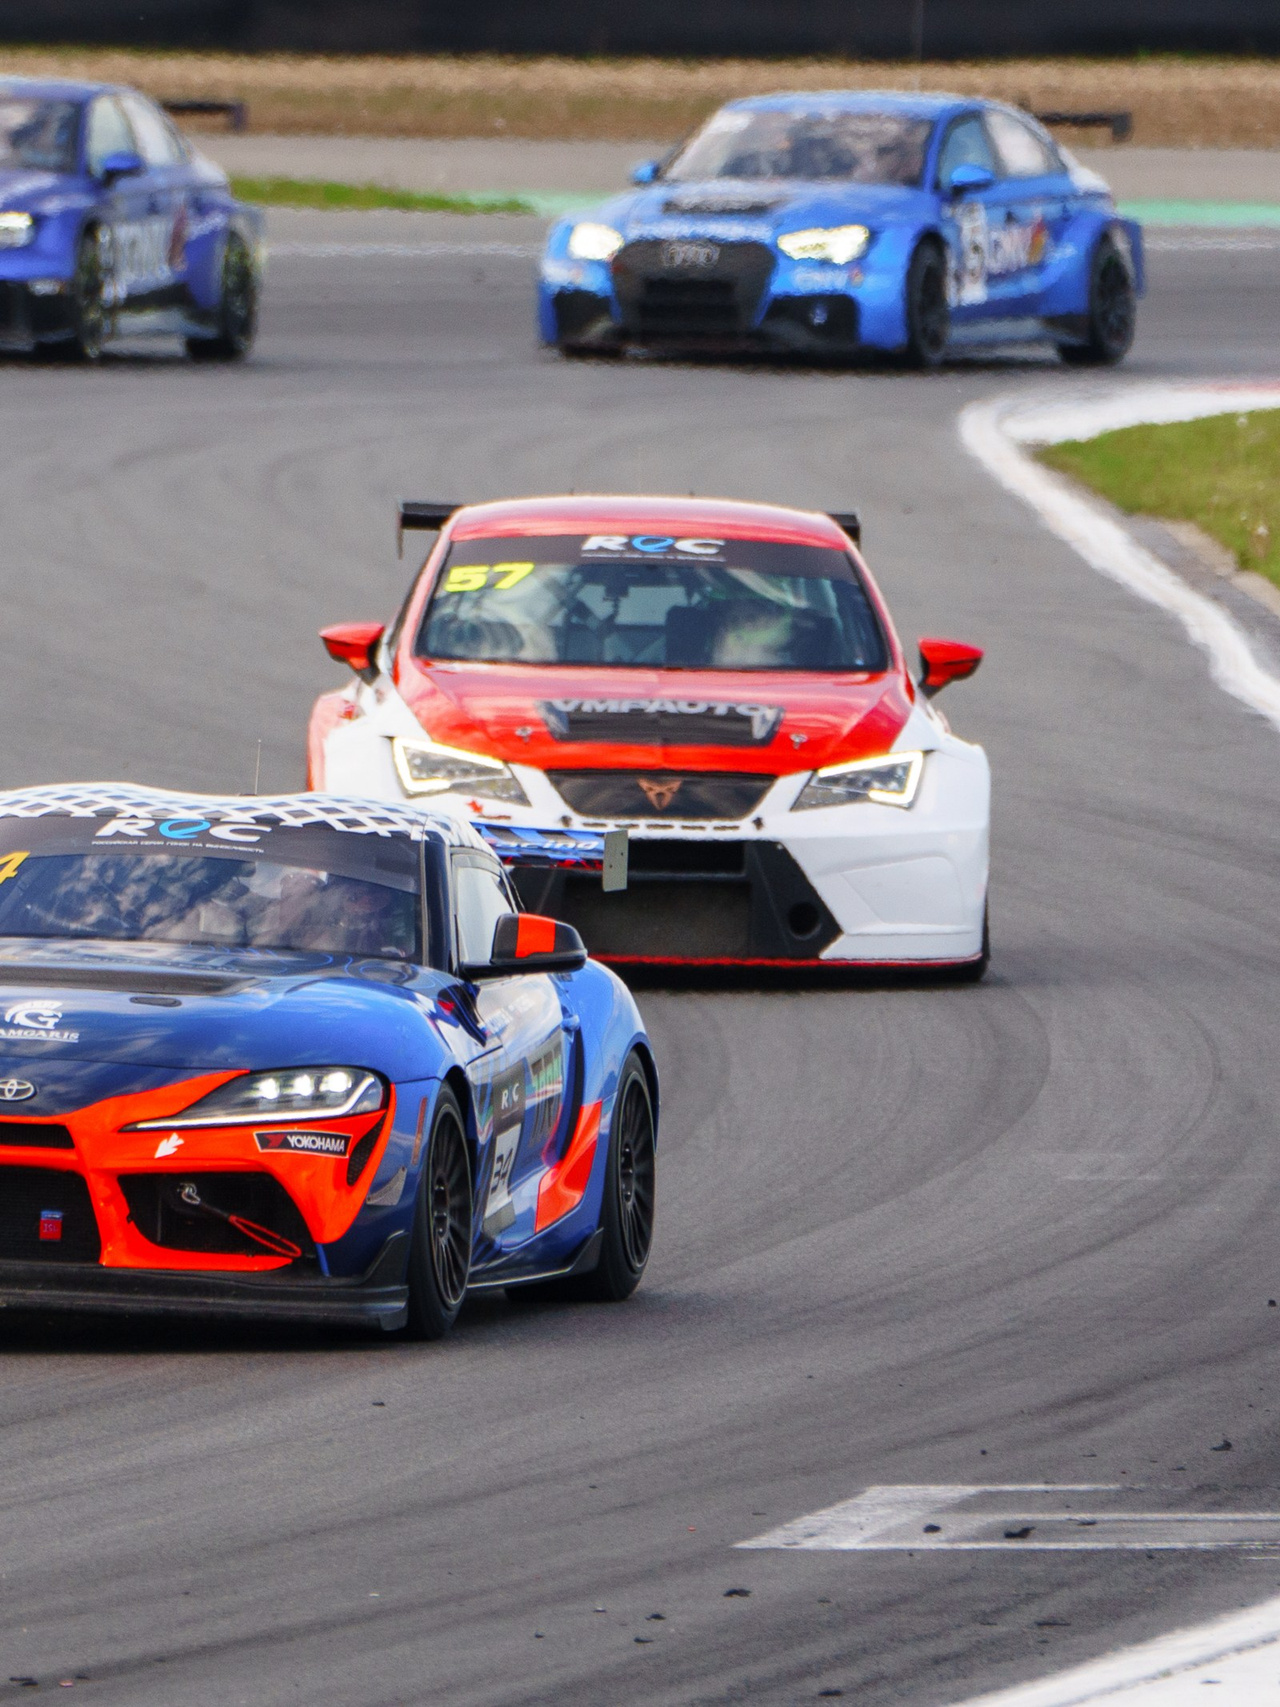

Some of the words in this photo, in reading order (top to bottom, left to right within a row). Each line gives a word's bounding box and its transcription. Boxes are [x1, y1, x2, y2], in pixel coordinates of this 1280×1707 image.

[445, 562, 535, 592] 57
[286, 1134, 346, 1152] YOKOHAMA
[489, 1147, 514, 1195] 34
